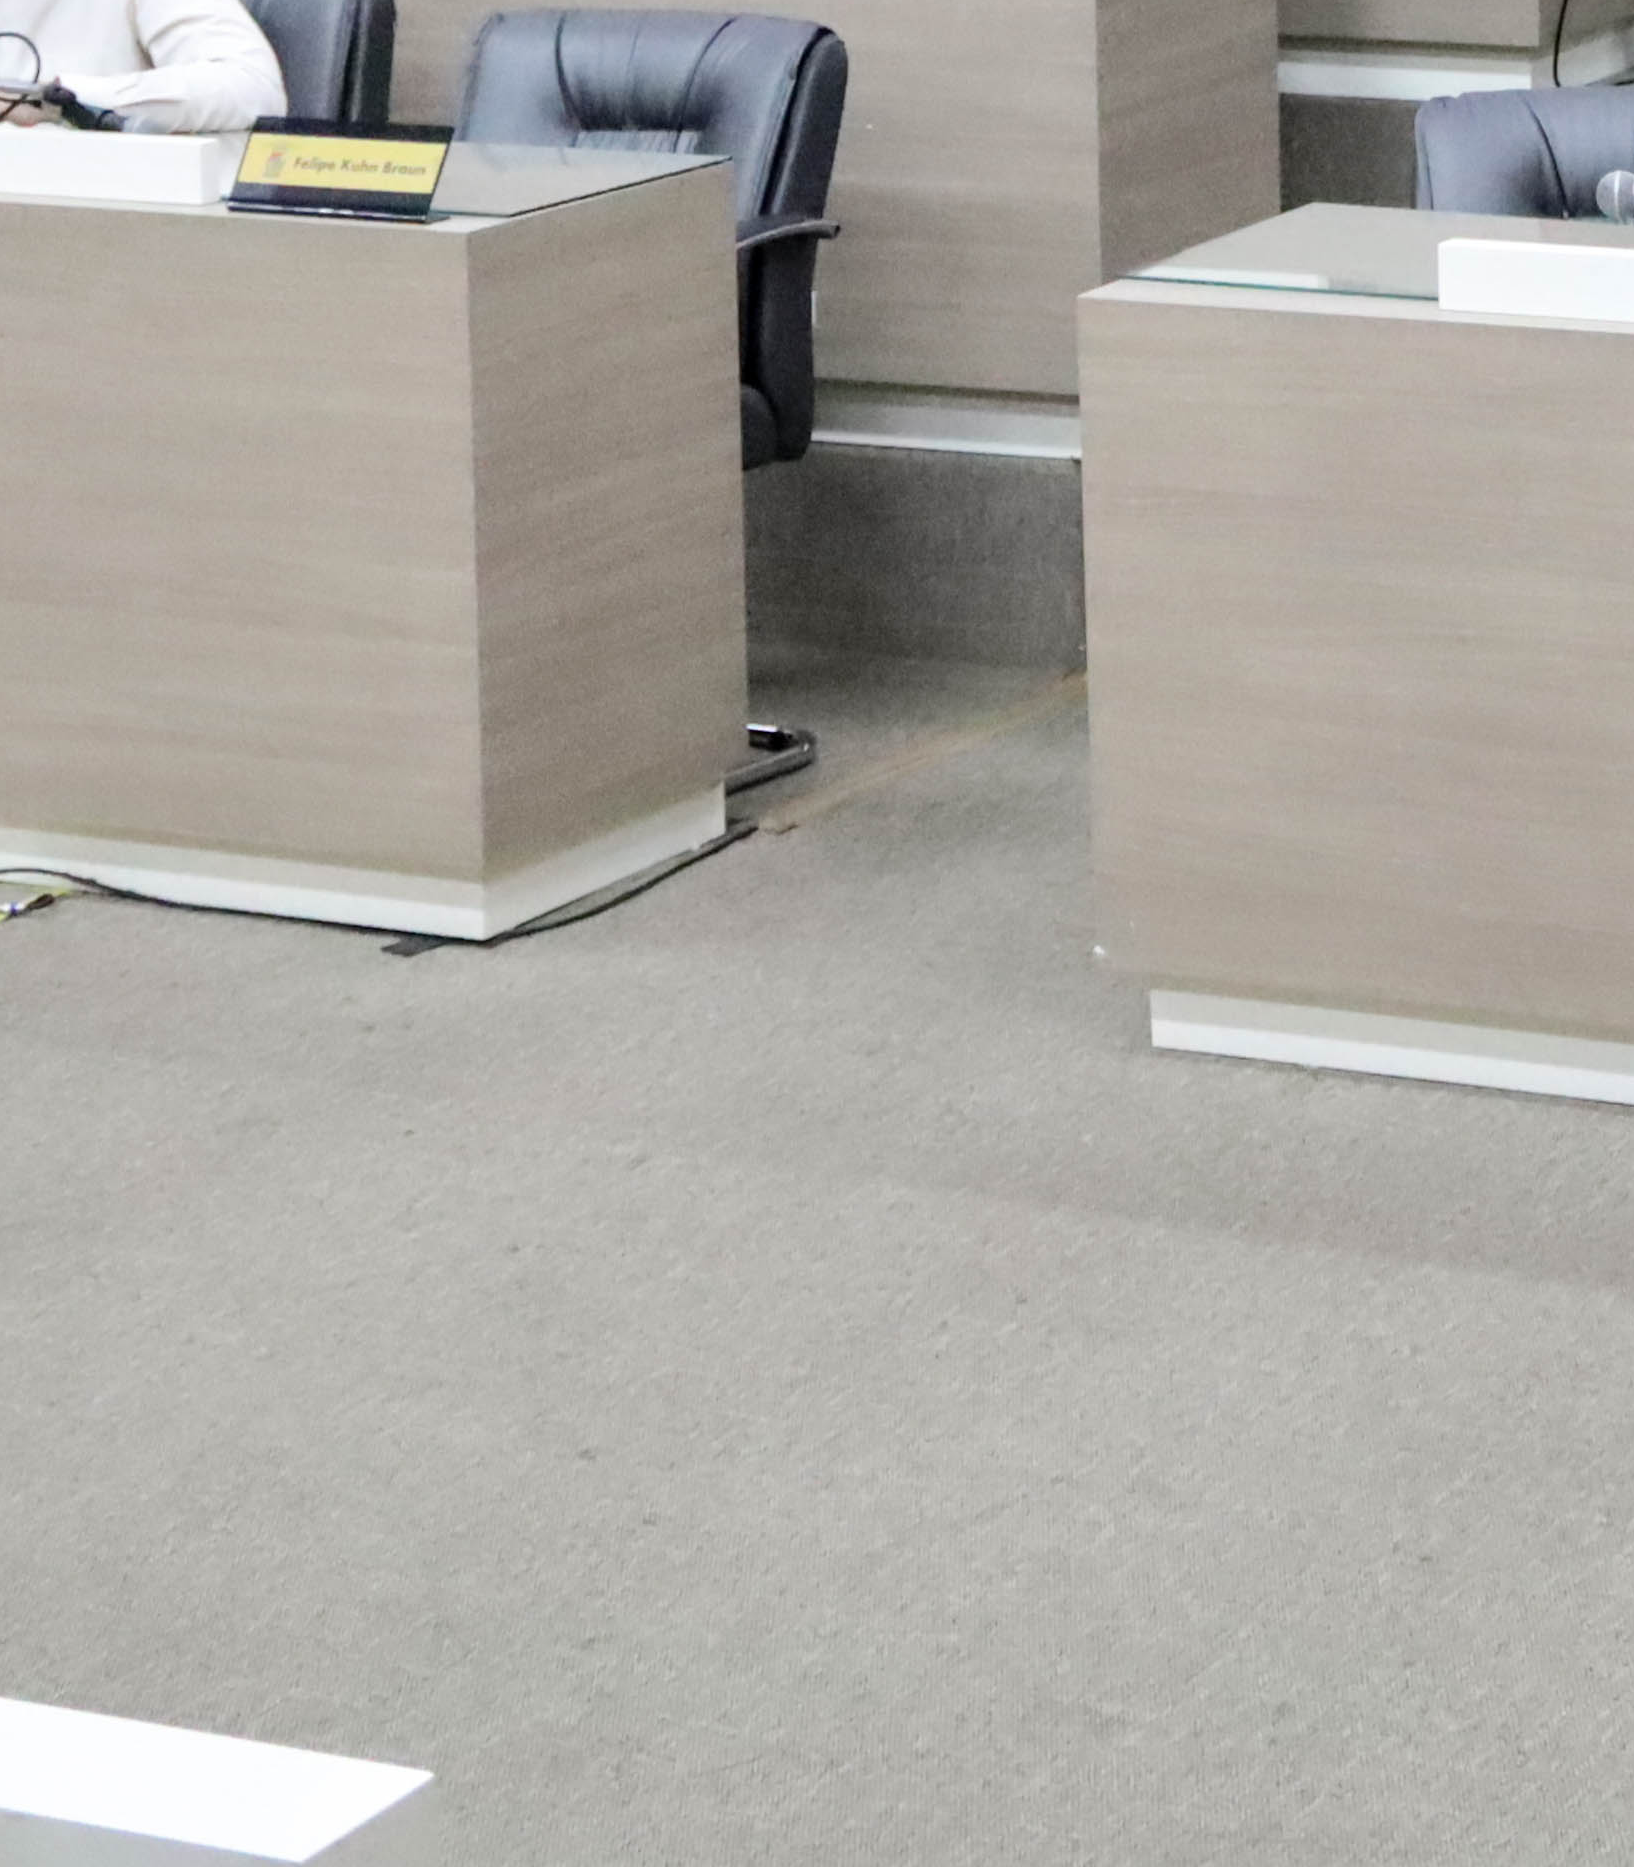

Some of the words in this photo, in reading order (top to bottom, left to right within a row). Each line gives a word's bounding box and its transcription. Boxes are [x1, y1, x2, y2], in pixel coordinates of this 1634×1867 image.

[293, 156, 336, 172] Felipe
[341, 158, 379, 173] Kuhn
[382, 160, 426, 176] Braun
